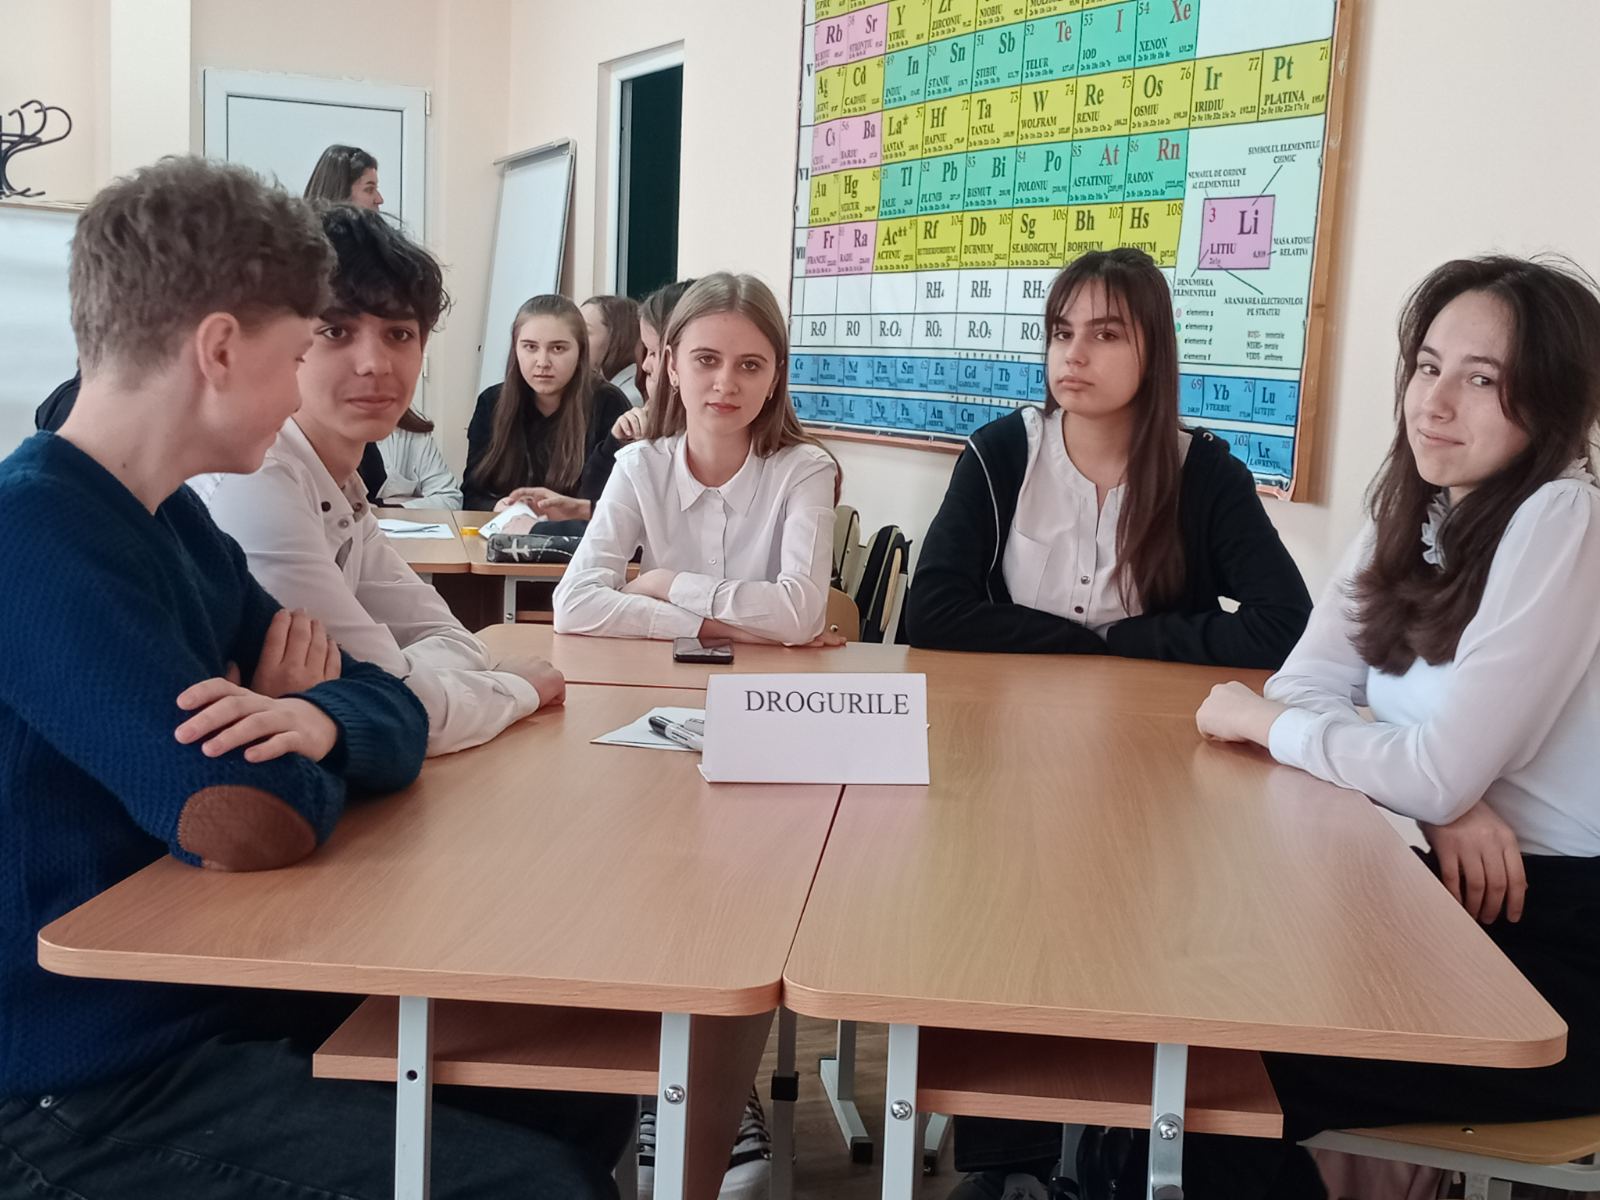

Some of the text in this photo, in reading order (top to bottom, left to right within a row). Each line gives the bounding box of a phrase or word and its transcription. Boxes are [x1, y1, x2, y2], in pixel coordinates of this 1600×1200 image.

[896, 5, 906, 26] Y
[1138, 2, 1150, 16] 54
[1170, 0, 1191, 24] Xe
[865, 14, 878, 34] Sr
[1115, 9, 1124, 33] I
[826, 24, 843, 44] Rb
[1026, 24, 1035, 36] 52
[1056, 20, 1072, 43] Te
[977, 34, 985, 46] 51
[998, 32, 1016, 54] Sb
[1139, 38, 1168, 53] XENON
[950, 42, 966, 63] Sn
[1082, 48, 1097, 60] IOD
[807, 64, 813, 77] V
[907, 56, 919, 76] In
[976, 66, 998, 80] STIBIU
[1026, 58, 1049, 71] TELUR
[1248, 57, 1260, 72] 77
[1272, 56, 1294, 83] Pt
[853, 66, 866, 87] Cd
[1122, 75, 1132, 89] 75
[1180, 66, 1192, 81] 76
[1204, 66, 1223, 92] Ir
[1065, 84, 1075, 96] 74
[1144, 74, 1164, 99] Os
[1033, 90, 1049, 113] W
[1084, 84, 1105, 107] Re
[1264, 90, 1305, 106] PLATINA
[960, 100, 969, 111] 72
[977, 98, 992, 120] Ta
[1134, 104, 1159, 118] OSMIU
[1195, 98, 1224, 113] IRIDIU
[930, 106, 947, 129] Hf
[1021, 116, 1057, 130] WOLFRAM
[1076, 110, 1100, 124] RENIU
[862, 120, 876, 140] Ba
[971, 124, 995, 136] TANTAL
[1098, 143, 1120, 167] At
[1156, 138, 1180, 162] Rn
[992, 156, 1006, 179] Bi
[1044, 150, 1062, 173] Po
[800, 168, 809, 181] VI
[901, 166, 912, 187] Tl
[942, 161, 958, 183] Pb
[1128, 171, 1154, 184] RADON
[844, 174, 859, 199] Hg
[1018, 180, 1048, 193] POLONIU
[1073, 174, 1113, 188] ASTATINIU
[814, 182, 827, 199] Au
[968, 186, 992, 198] BISMUT
[1053, 209, 1067, 221] 106
[1108, 207, 1123, 219] 107
[1130, 207, 1150, 229] Hs
[1166, 203, 1183, 216] 108
[1209, 208, 1217, 223] 3
[970, 216, 987, 237] Db
[1020, 213, 1037, 239] Sg
[1075, 210, 1095, 231] Bh
[1238, 208, 1259, 236] Li
[854, 228, 868, 248] Ra
[924, 220, 939, 240] Rf
[824, 231, 834, 249] Fr
[1012, 242, 1057, 254] SEABORGIUM
[796, 247, 806, 260] VII
[1210, 243, 1237, 255] LITIU
[846, 320, 860, 337] RO
[901, 361, 915, 375] Sm
[964, 366, 977, 379] Gd
[998, 368, 1011, 382] Tb
[1214, 384, 1230, 401] Yb
[1262, 387, 1275, 404] Lu
[961, 408, 975, 423] Cm
[1258, 442, 1270, 459] Lr
[745, 690, 910, 715] DROGURILE
